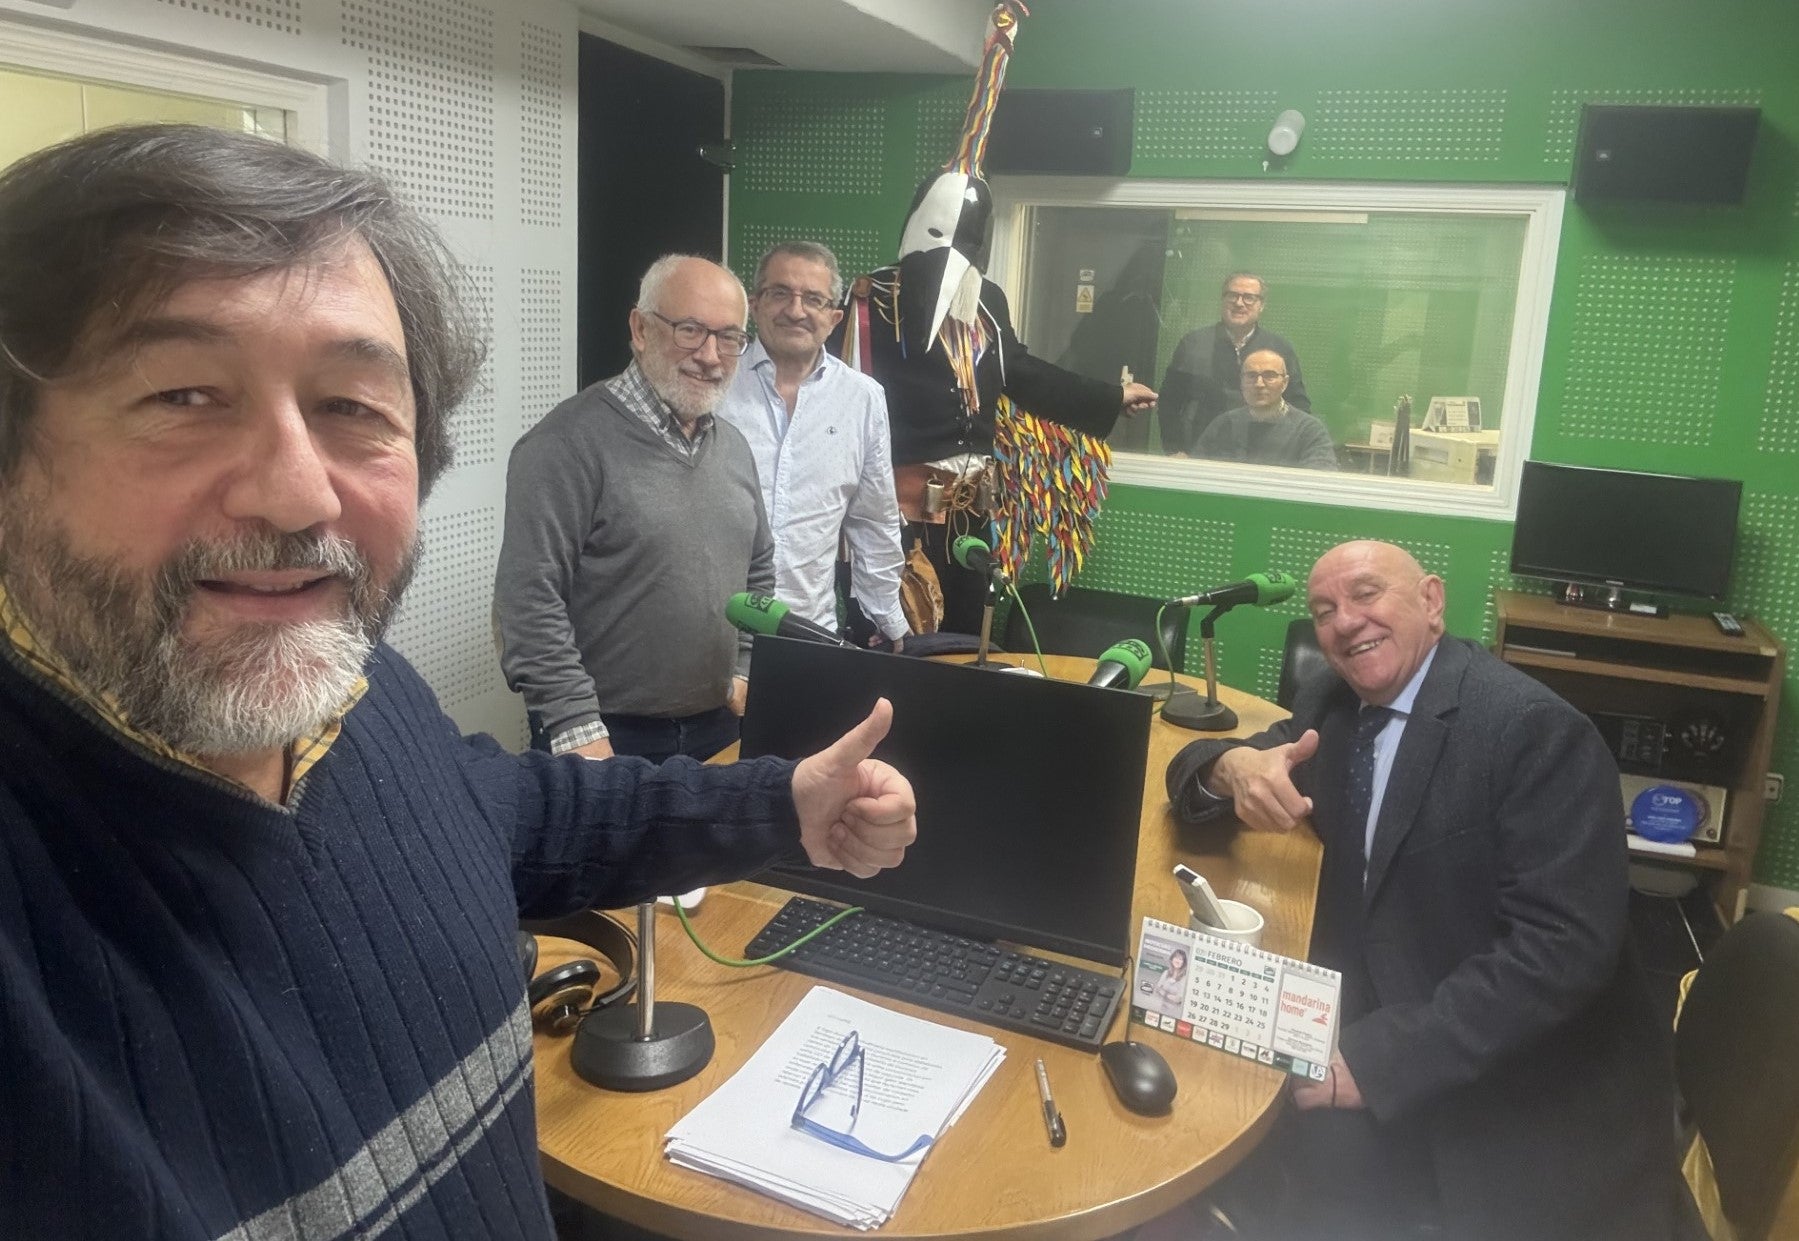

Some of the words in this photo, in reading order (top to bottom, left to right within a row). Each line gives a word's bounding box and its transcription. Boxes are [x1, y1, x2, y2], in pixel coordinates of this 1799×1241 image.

[1208, 950, 1243, 967] FEBRERO
[1237, 1002, 1244, 1010] 16
[1259, 1009, 1267, 1017] 18
[1280, 1001, 1305, 1018] home
[1282, 990, 1331, 1013] mandarina
[1200, 1003, 1209, 1011] 20
[1212, 1007, 1219, 1015] 21
[1223, 1010, 1231, 1018] 22
[1234, 1014, 1243, 1022] 23
[1245, 1017, 1254, 1025] 24
[1257, 1021, 1265, 1029] 25
[1209, 1018, 1218, 1027] 28
[1221, 1022, 1230, 1030] 29
